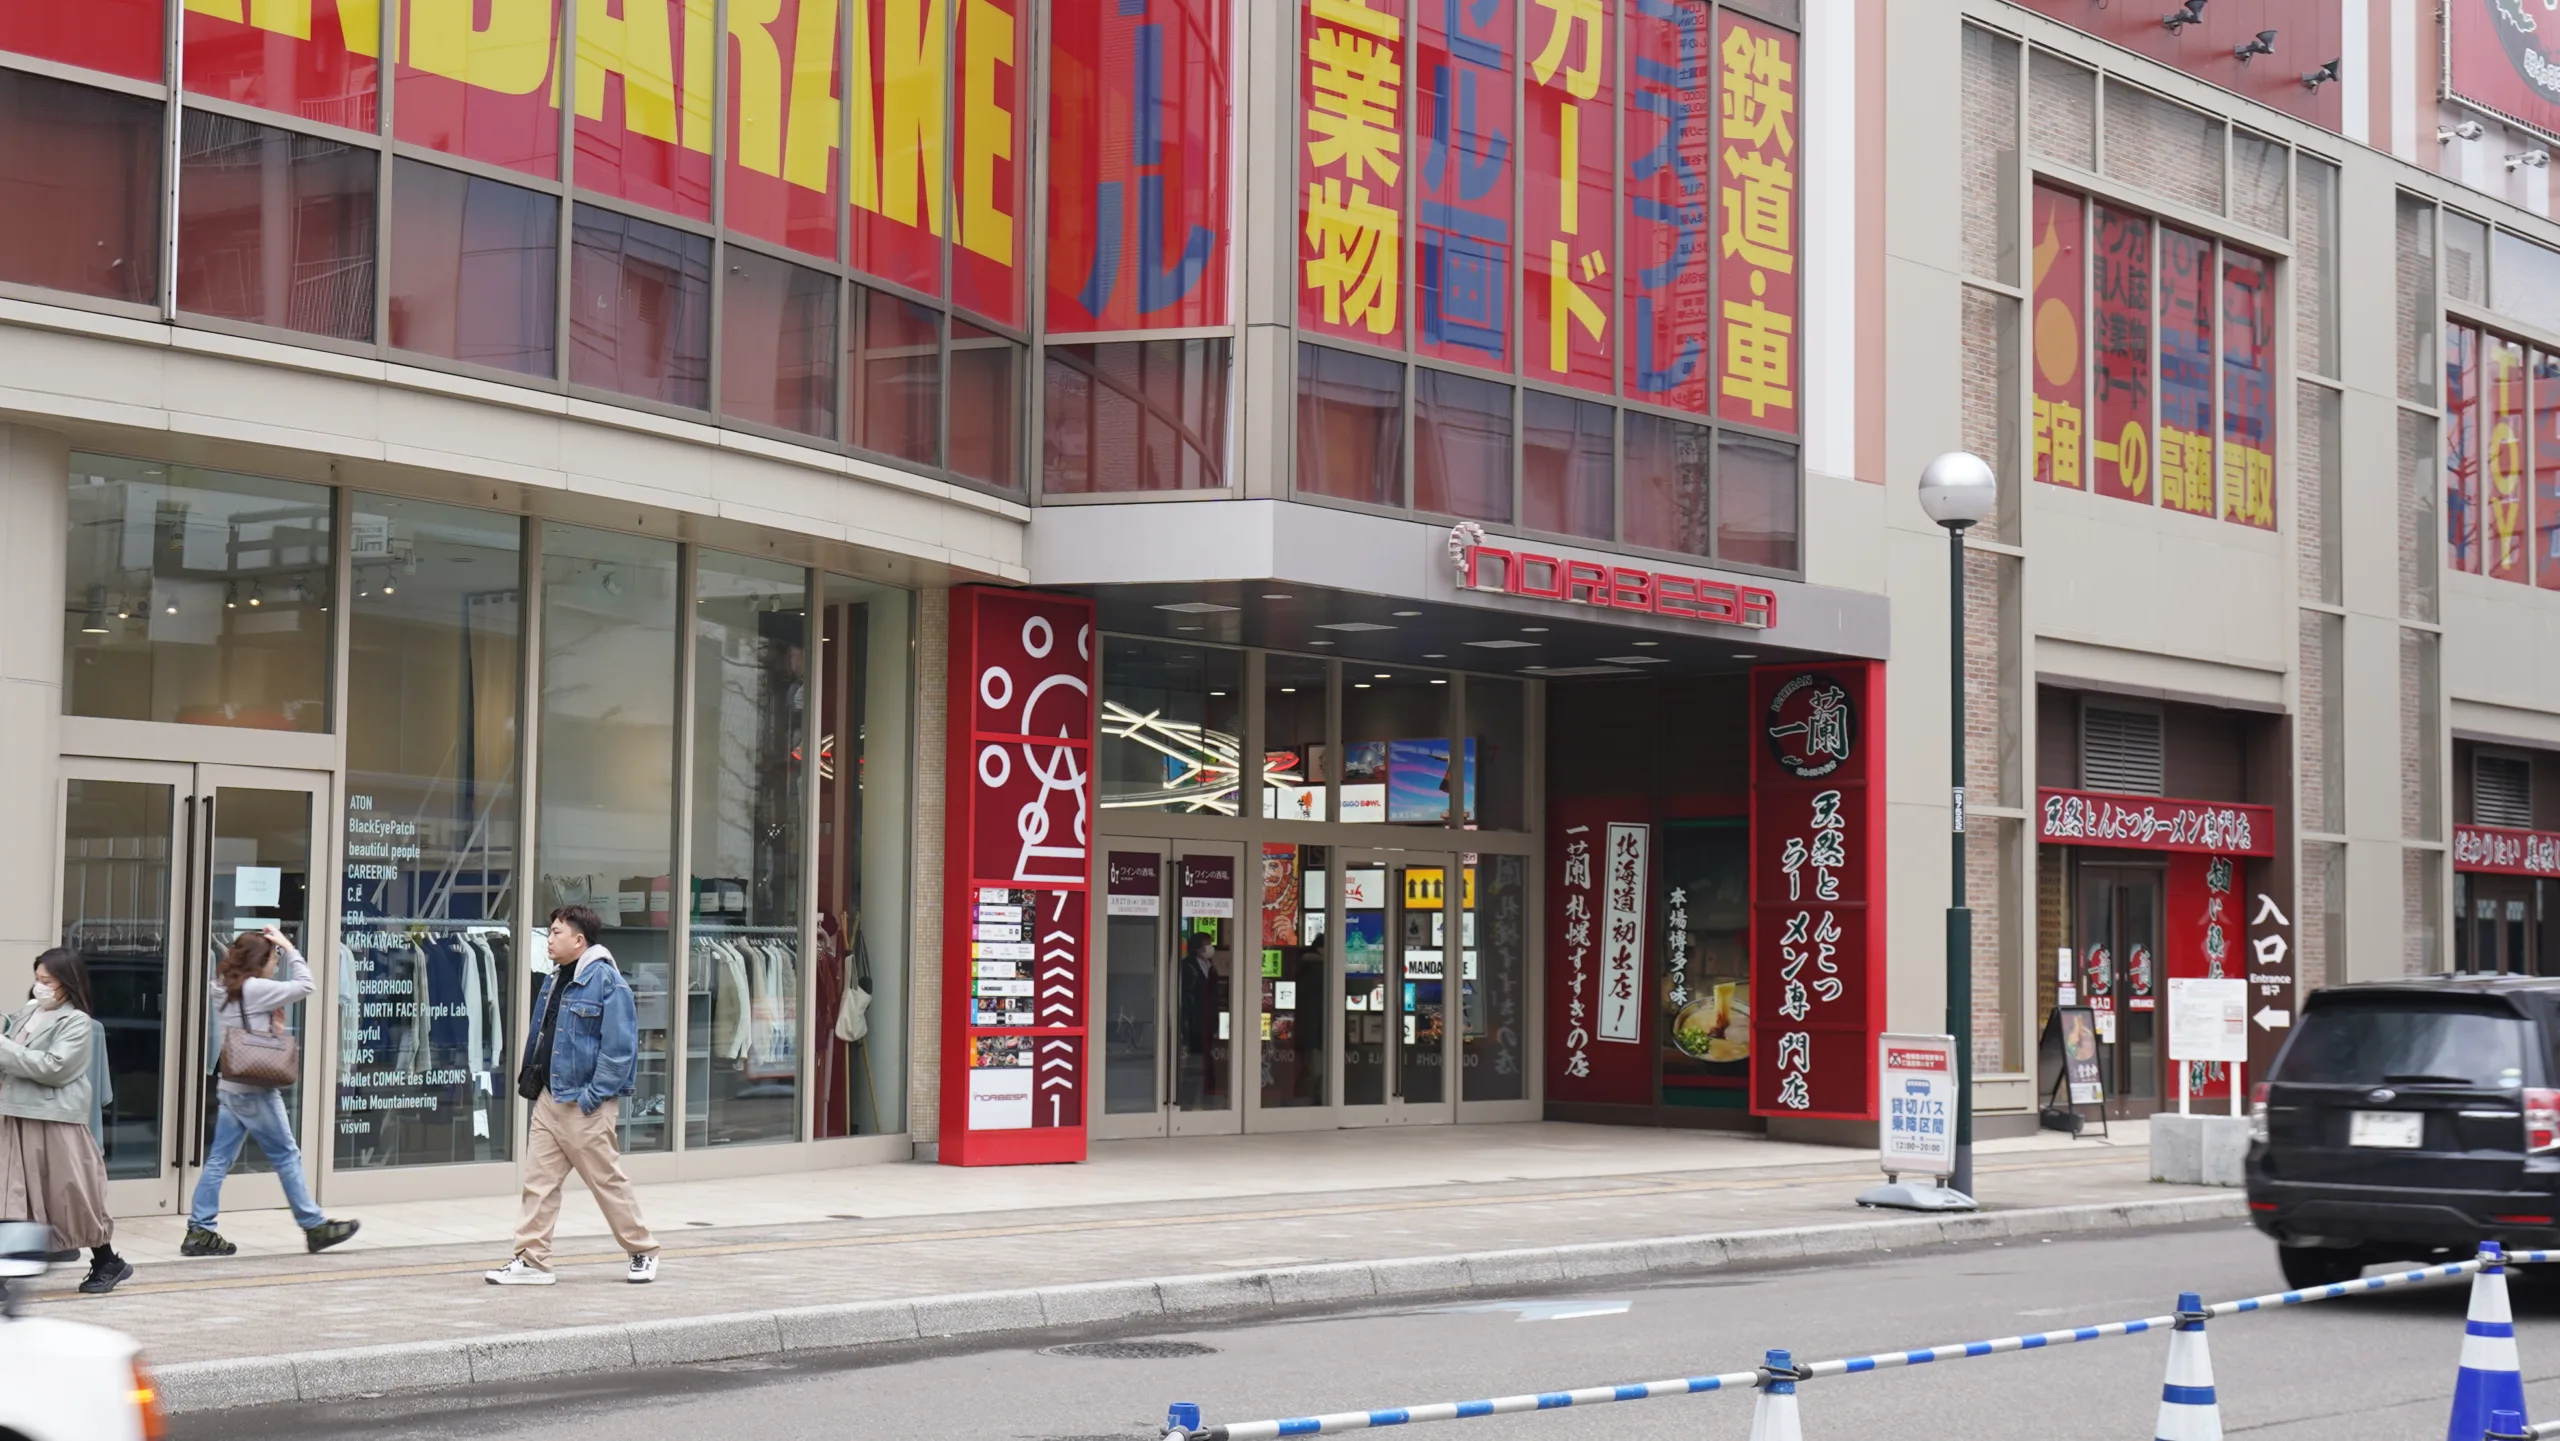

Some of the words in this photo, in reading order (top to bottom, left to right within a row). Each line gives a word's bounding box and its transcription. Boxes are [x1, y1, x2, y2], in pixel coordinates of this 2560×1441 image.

[1075, 0, 1216, 320] ール
[1721, 24, 1795, 419] 鉄道・車
[1769, 686, 1849, 760] 一蘭
[350, 795, 372, 811] ATON
[349, 817, 415, 837] BlackEyePatch
[348, 841, 389, 857] beautiful
[391, 843, 420, 861] people
[348, 864, 398, 880] CAREERING
[1811, 789, 1845, 1001] 天然とんこつ
[1052, 890, 1069, 923] 7
[2250, 893, 2291, 965] 入口
[1669, 886, 1688, 1007] 本場博多の味
[1408, 961, 1469, 975] MANDAE
[1778, 837, 1811, 1110] ラーメン専門店
[2249, 972, 2292, 984] Entrance
[363, 1002, 394, 1018] NORTH
[396, 1002, 417, 1018] FACE
[420, 1003, 448, 1020] Purple
[342, 1071, 371, 1087] Wallet
[372, 1070, 405, 1086] COMME
[407, 1071, 424, 1085] des
[341, 1095, 367, 1111] White
[369, 1095, 438, 1112] Mountaineering
[1050, 1094, 1060, 1128] 1
[1892, 1098, 1944, 1116] 貸切バス
[340, 1119, 370, 1134] visvim
[1892, 1115, 1944, 1134] 乗降区間
